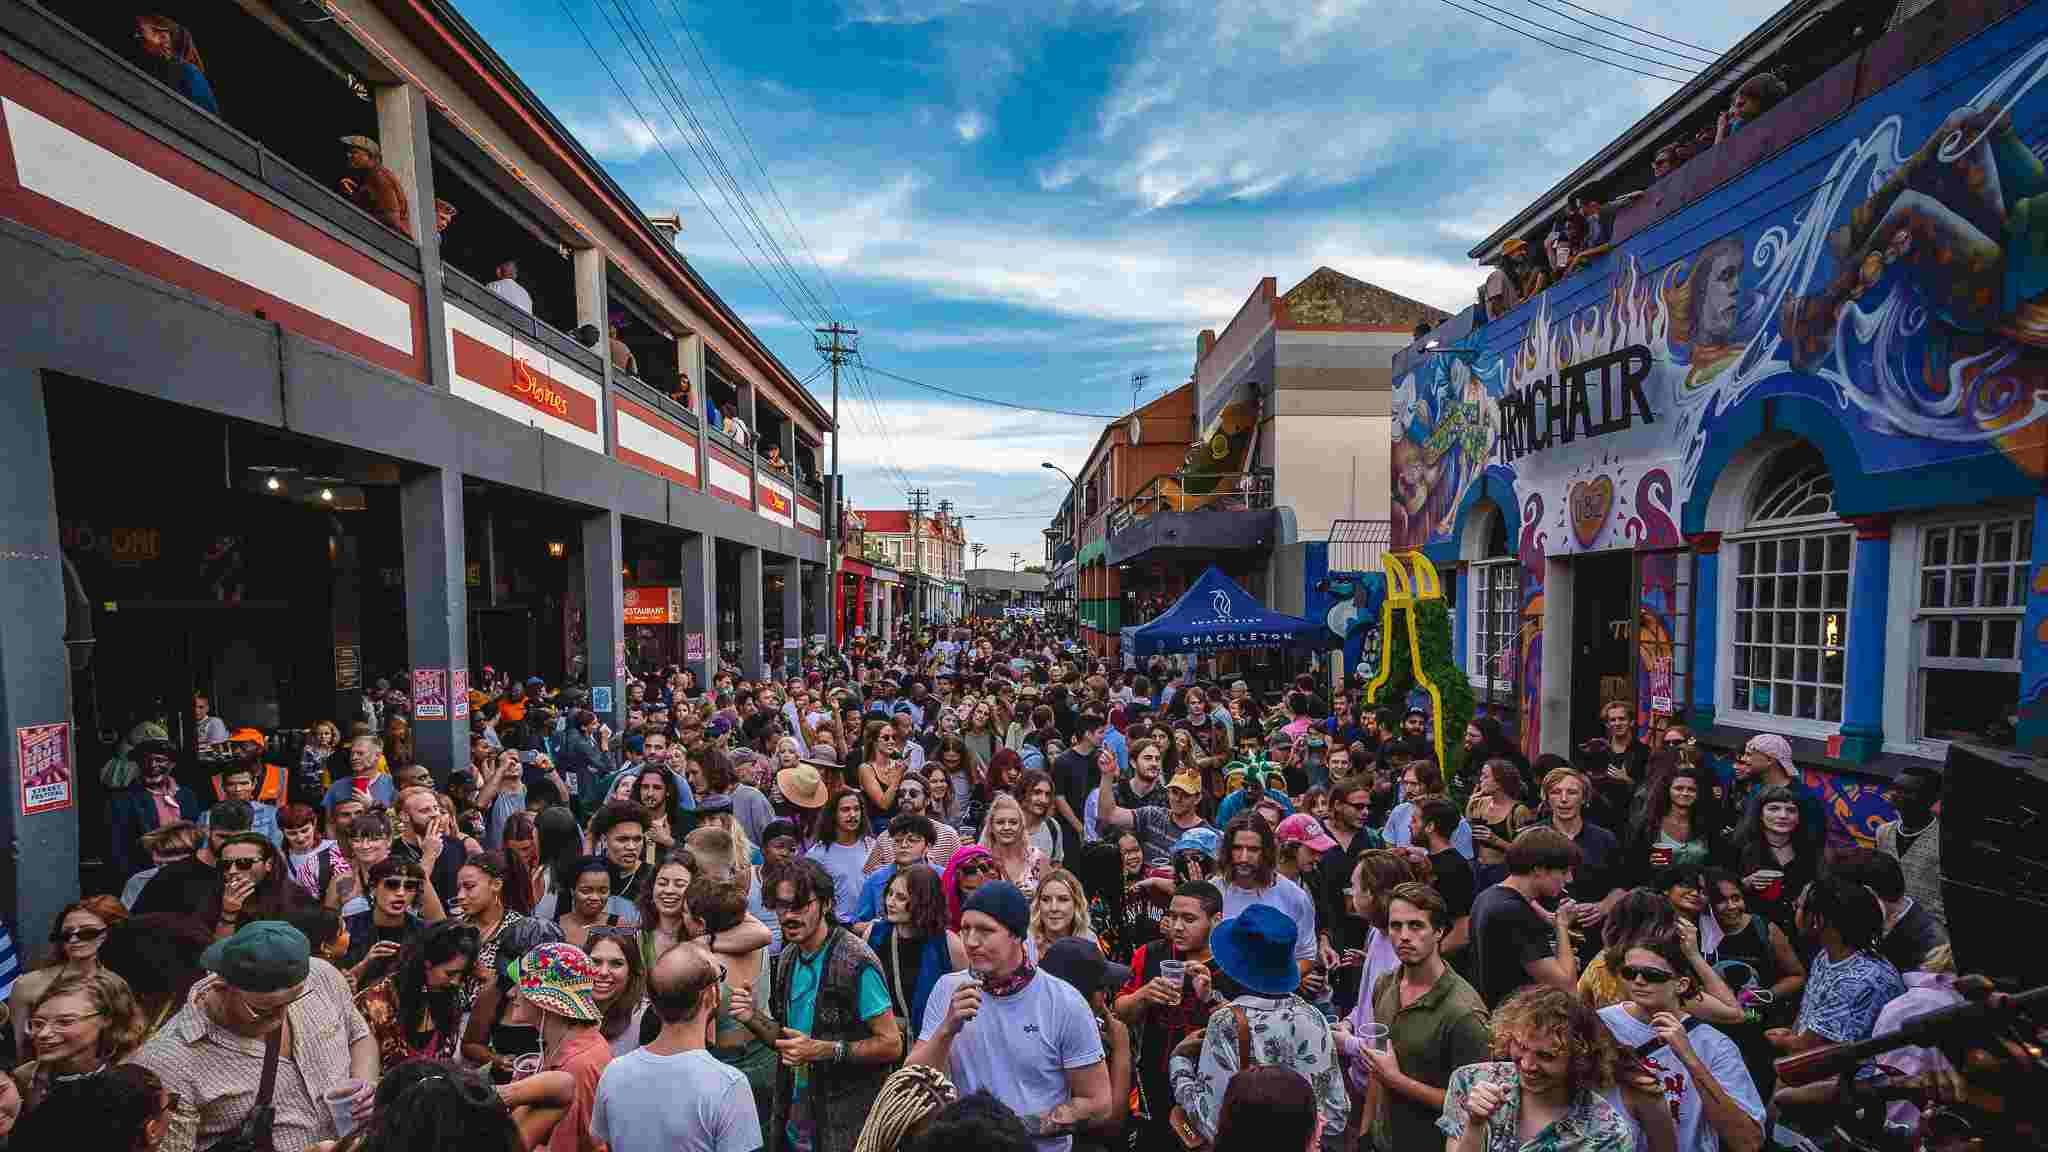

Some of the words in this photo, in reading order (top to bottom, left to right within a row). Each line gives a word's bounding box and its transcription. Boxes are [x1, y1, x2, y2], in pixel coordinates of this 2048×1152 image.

[512, 358, 568, 415] Stones
[1499, 344, 1655, 464] ARMCHAIR
[624, 607, 665, 617] ESTAURANT
[1182, 631, 1293, 646] SHACKLETON
